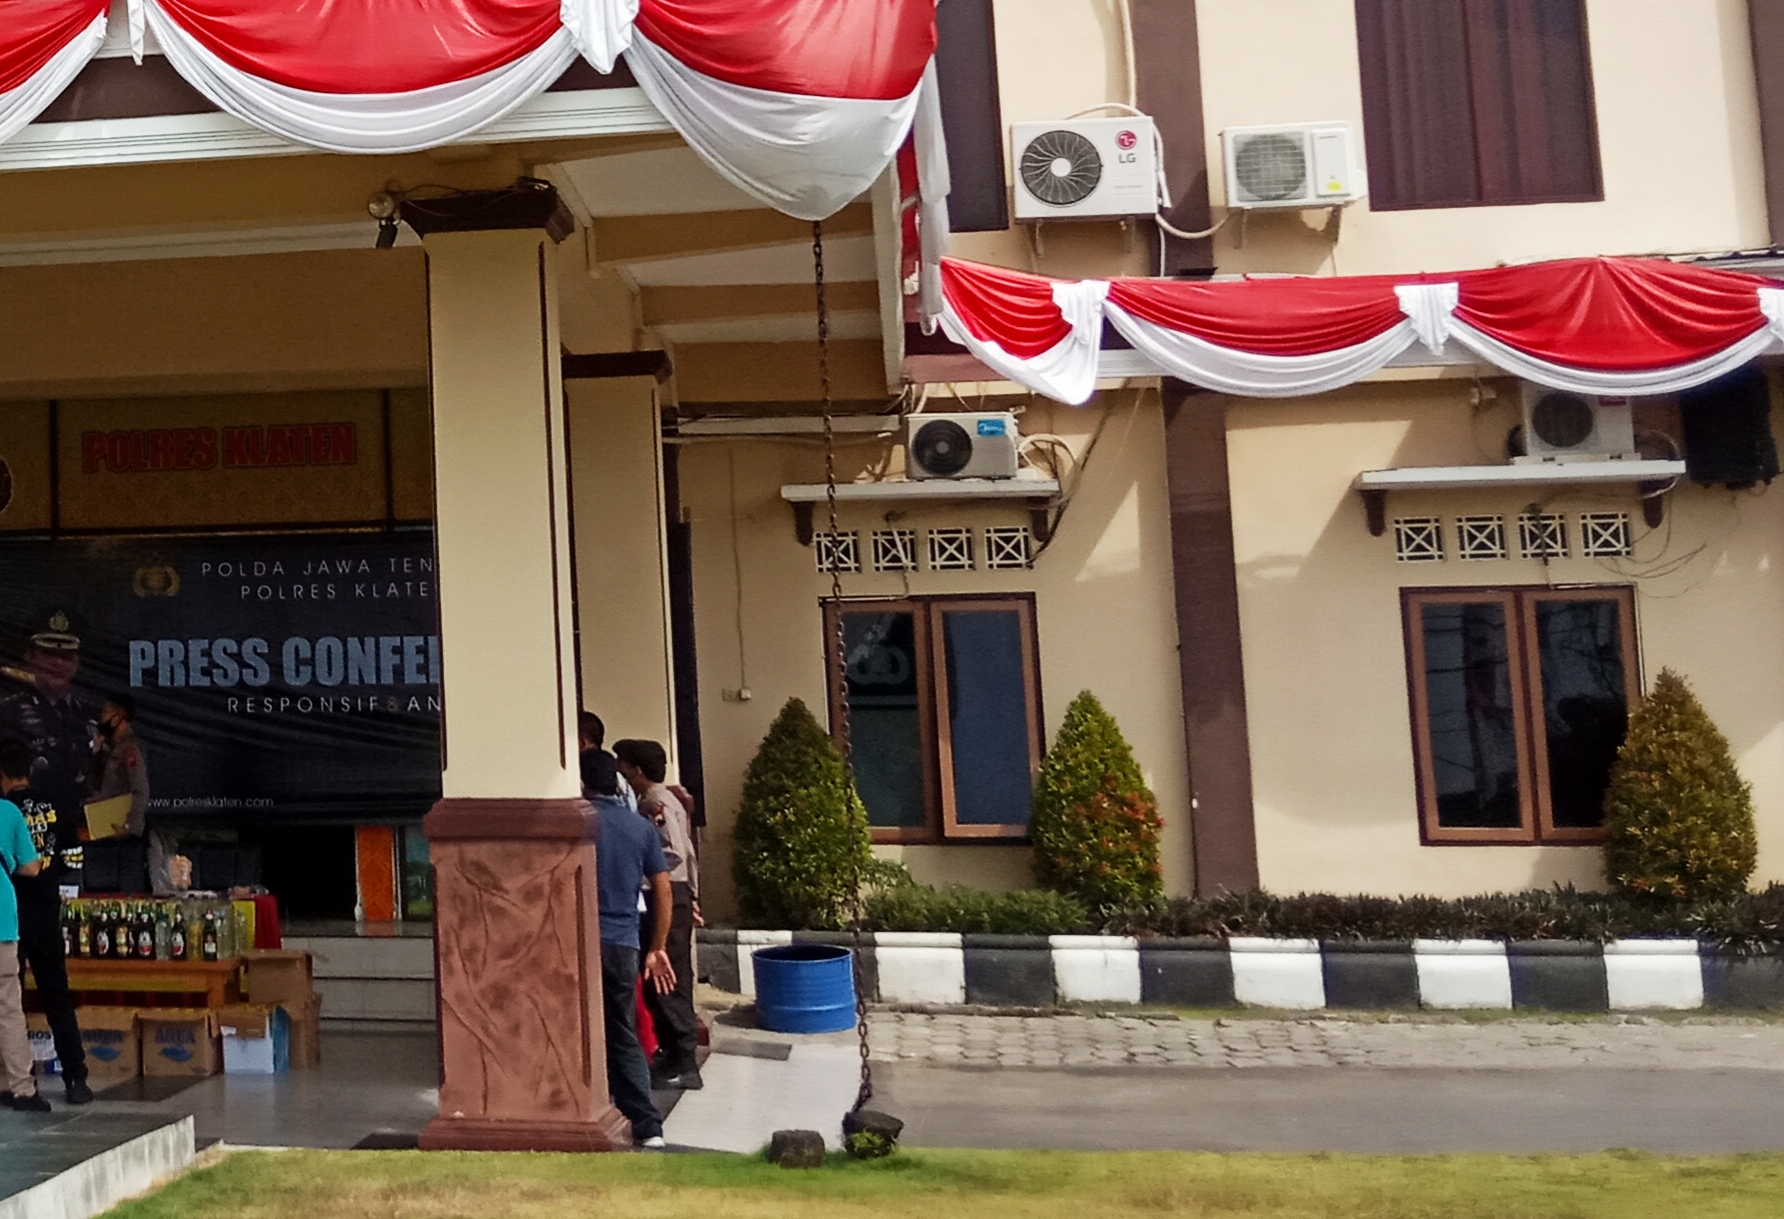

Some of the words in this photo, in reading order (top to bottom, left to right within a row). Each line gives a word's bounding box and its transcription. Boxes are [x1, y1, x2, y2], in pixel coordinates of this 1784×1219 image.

[1118, 152, 1136, 164] LG
[82, 427, 216, 474] POLRES
[222, 422, 357, 468] KLATEN
[202, 561, 285, 577] POLDA
[303, 558, 371, 576] JAWA
[241, 583, 337, 600] POLRES
[128, 637, 271, 688] PRESS
[227, 697, 379, 713] RESPONSIF
